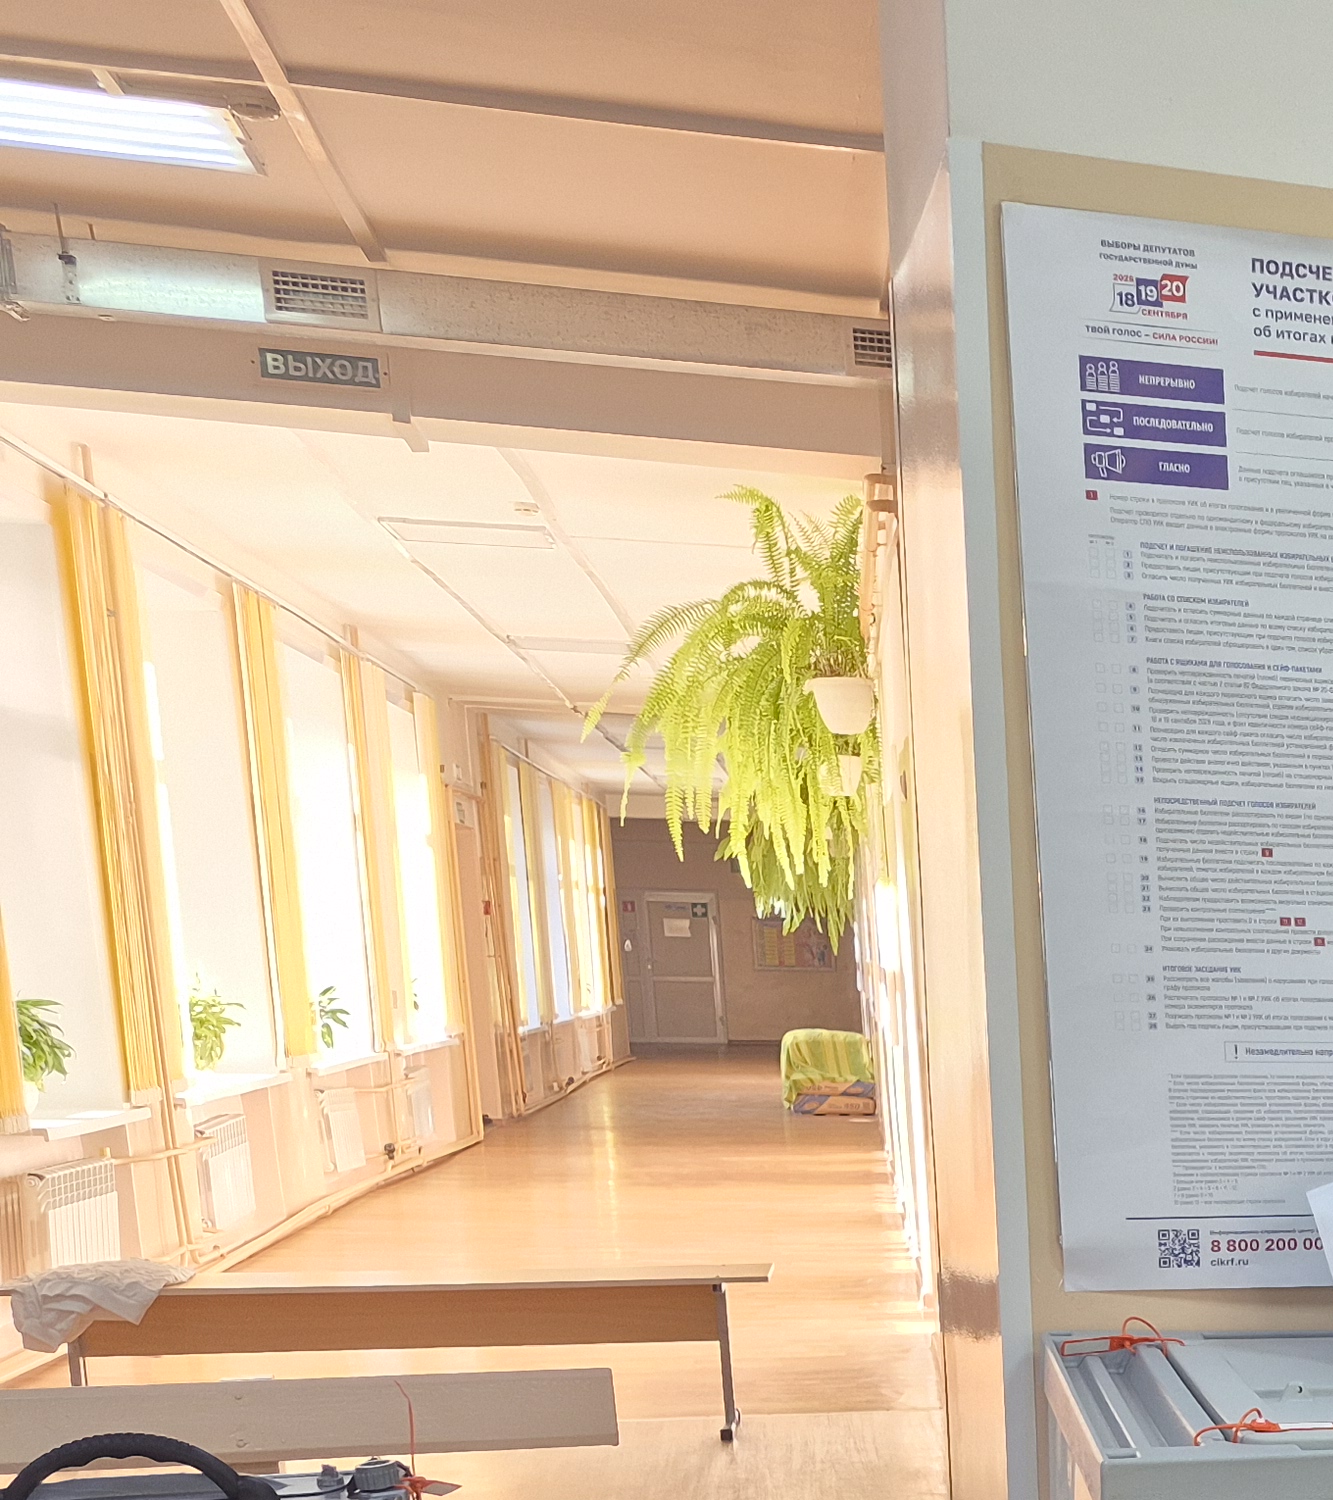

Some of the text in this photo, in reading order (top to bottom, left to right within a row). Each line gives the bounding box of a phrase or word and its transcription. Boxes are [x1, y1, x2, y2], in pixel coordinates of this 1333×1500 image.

[1101, 239, 1195, 257] ВЫБОРЫ ДЕПУТАТОВ
[1117, 280, 1184, 307] 18 19 20
[1142, 308, 1188, 320] СЕНТЯБРЯ
[1252, 307, 1261, 317] с
[1085, 324, 1110, 334] ТВОЙ
[1112, 328, 1142, 338] ГОЛОС
[1152, 332, 1177, 342] СИЛА
[1254, 326, 1272, 338] об
[1276, 329, 1326, 344] итогах
[266, 352, 376, 384] ВЫХОД
[1139, 374, 1195, 389] НЕПРЕРЫВНО
[1133, 416, 1213, 432] ПОСЛЕДОВАТЕЛЬНО
[1159, 462, 1190, 473] ГЛАСНО
[1211, 1240, 1221, 1252] 8
[1226, 1239, 1259, 1252] 800
[1265, 1238, 1297, 1251] 200
[1210, 1258, 1249, 1266] cikrf.ru
